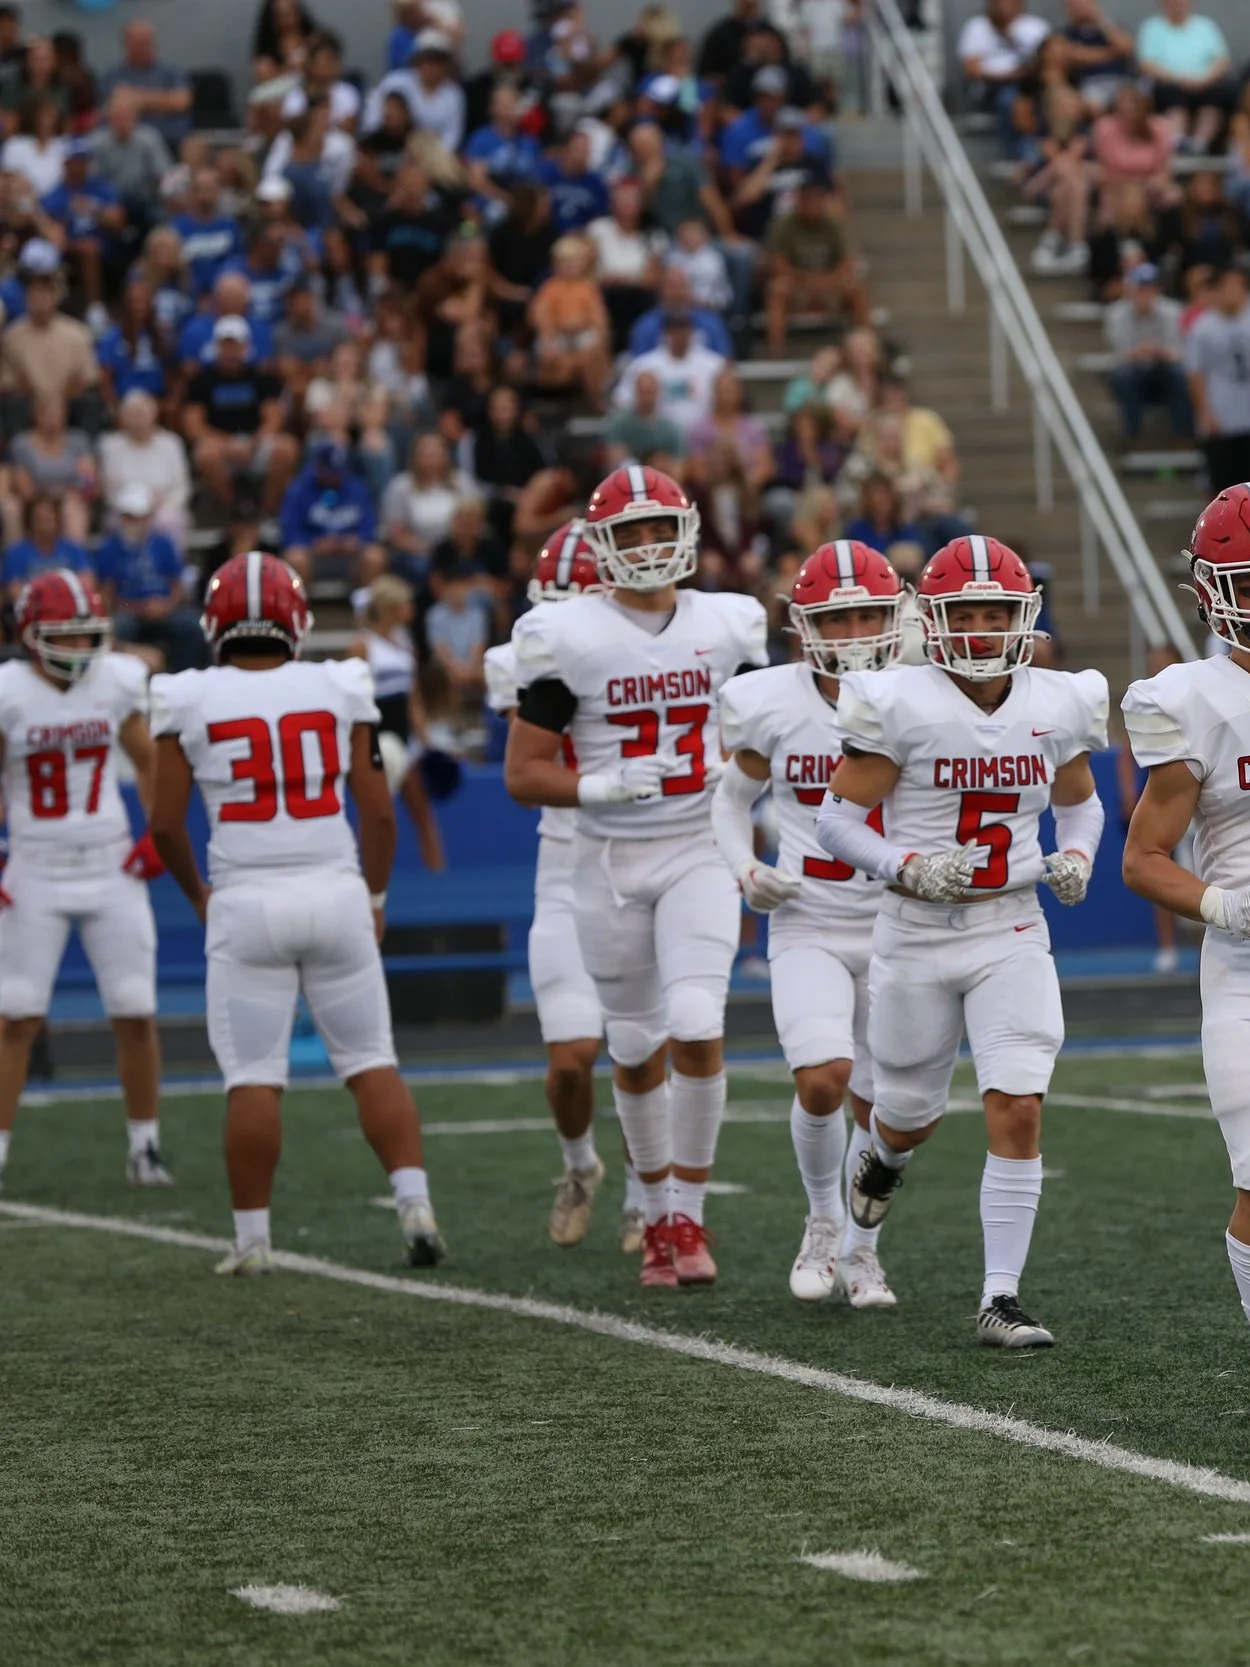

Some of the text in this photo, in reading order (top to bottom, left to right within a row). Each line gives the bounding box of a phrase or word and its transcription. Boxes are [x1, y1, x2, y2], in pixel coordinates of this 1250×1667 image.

[606, 667, 712, 706] CRIMSON
[26, 745, 109, 819] 87
[207, 710, 341, 823] 30
[934, 753, 1048, 789] CRIMSON
[955, 791, 1021, 889] 5
